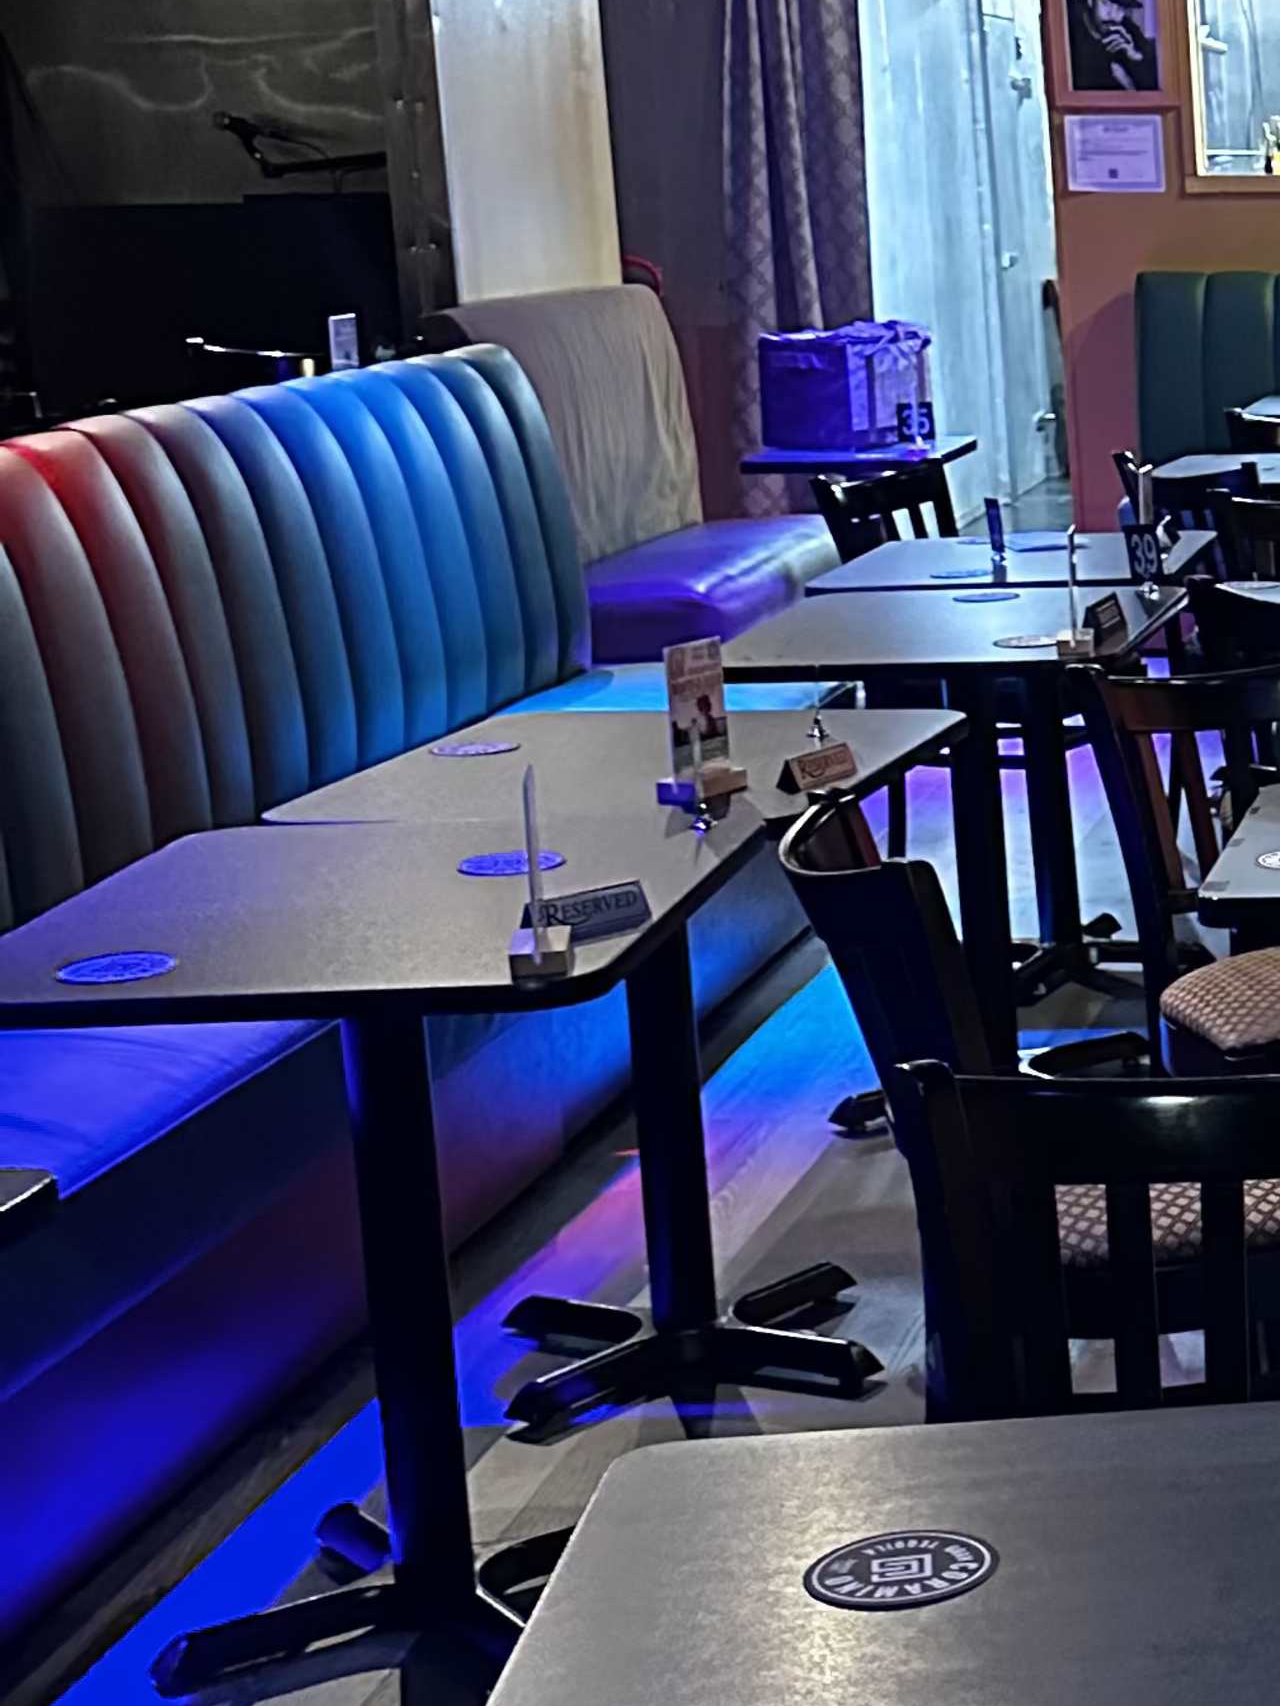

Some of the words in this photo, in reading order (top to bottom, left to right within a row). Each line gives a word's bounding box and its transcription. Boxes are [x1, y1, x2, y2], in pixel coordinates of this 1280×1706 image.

[1130, 532, 1159, 575] 39
[542, 889, 639, 928] RESERVED
[860, 1539, 940, 1557] TEQUILA
[823, 1560, 981, 1599] CORAMINO
